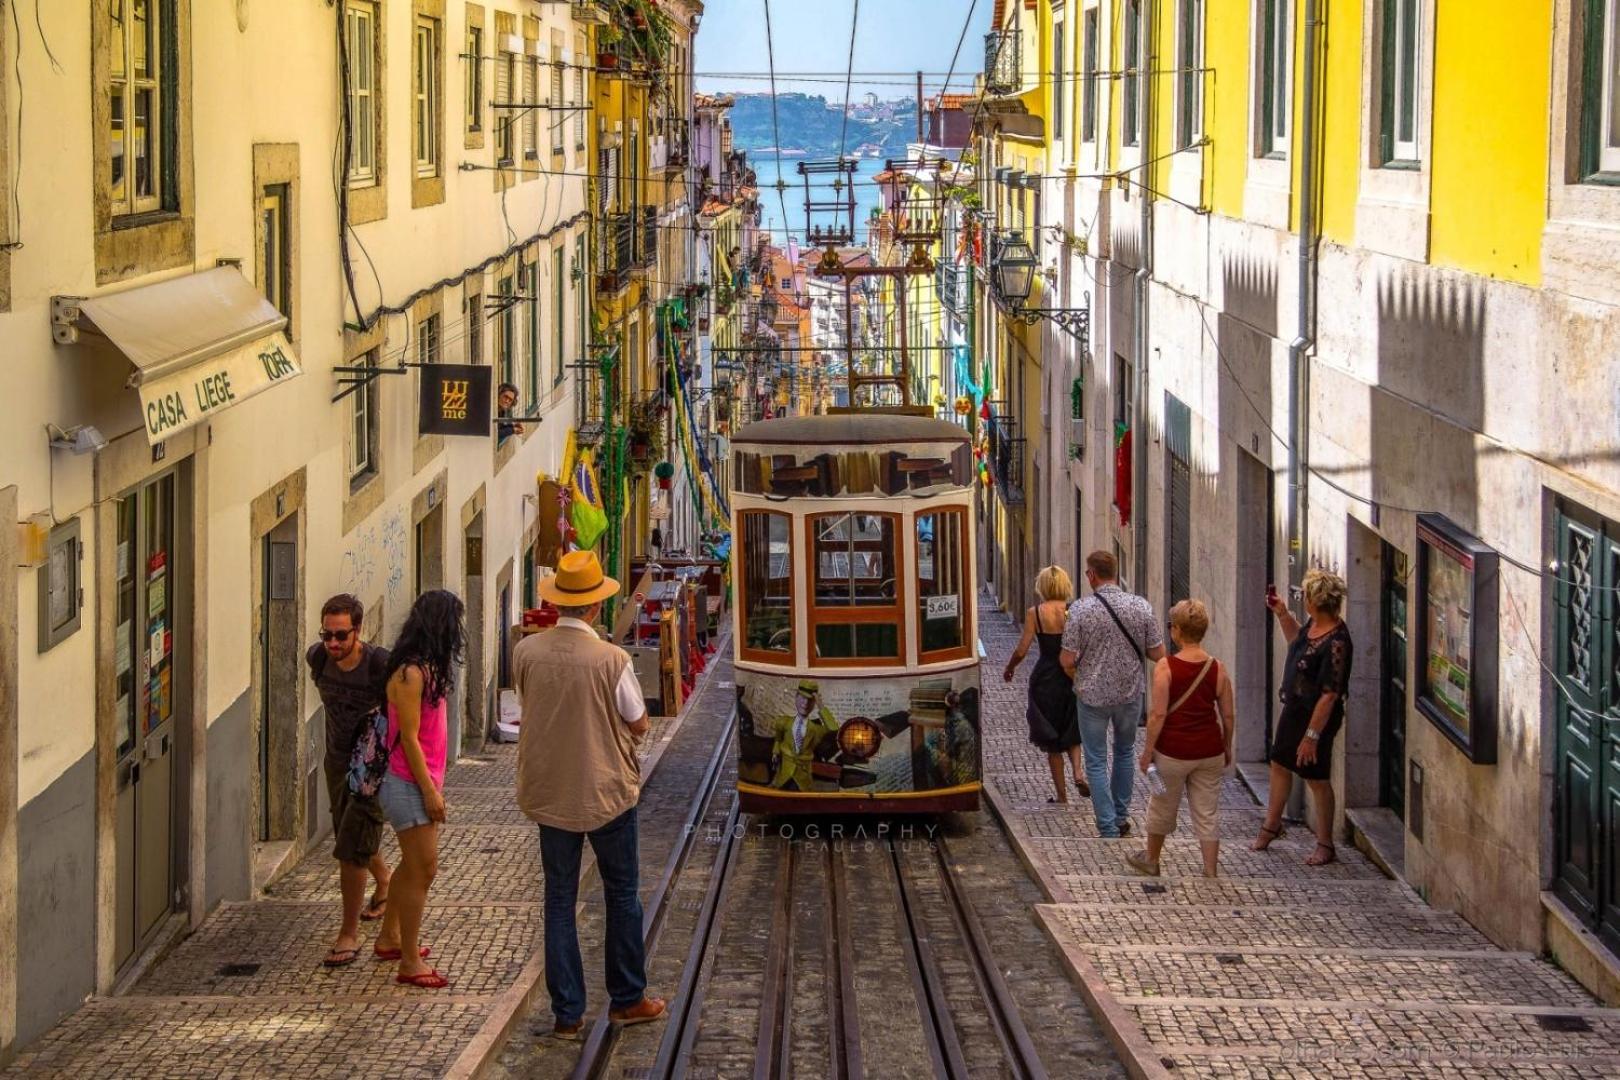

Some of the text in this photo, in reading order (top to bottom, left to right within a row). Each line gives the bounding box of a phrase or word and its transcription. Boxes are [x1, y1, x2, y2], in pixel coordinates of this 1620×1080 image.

[147, 346, 295, 435] CASA LIEGE TOFA
[443, 410, 467, 420] me
